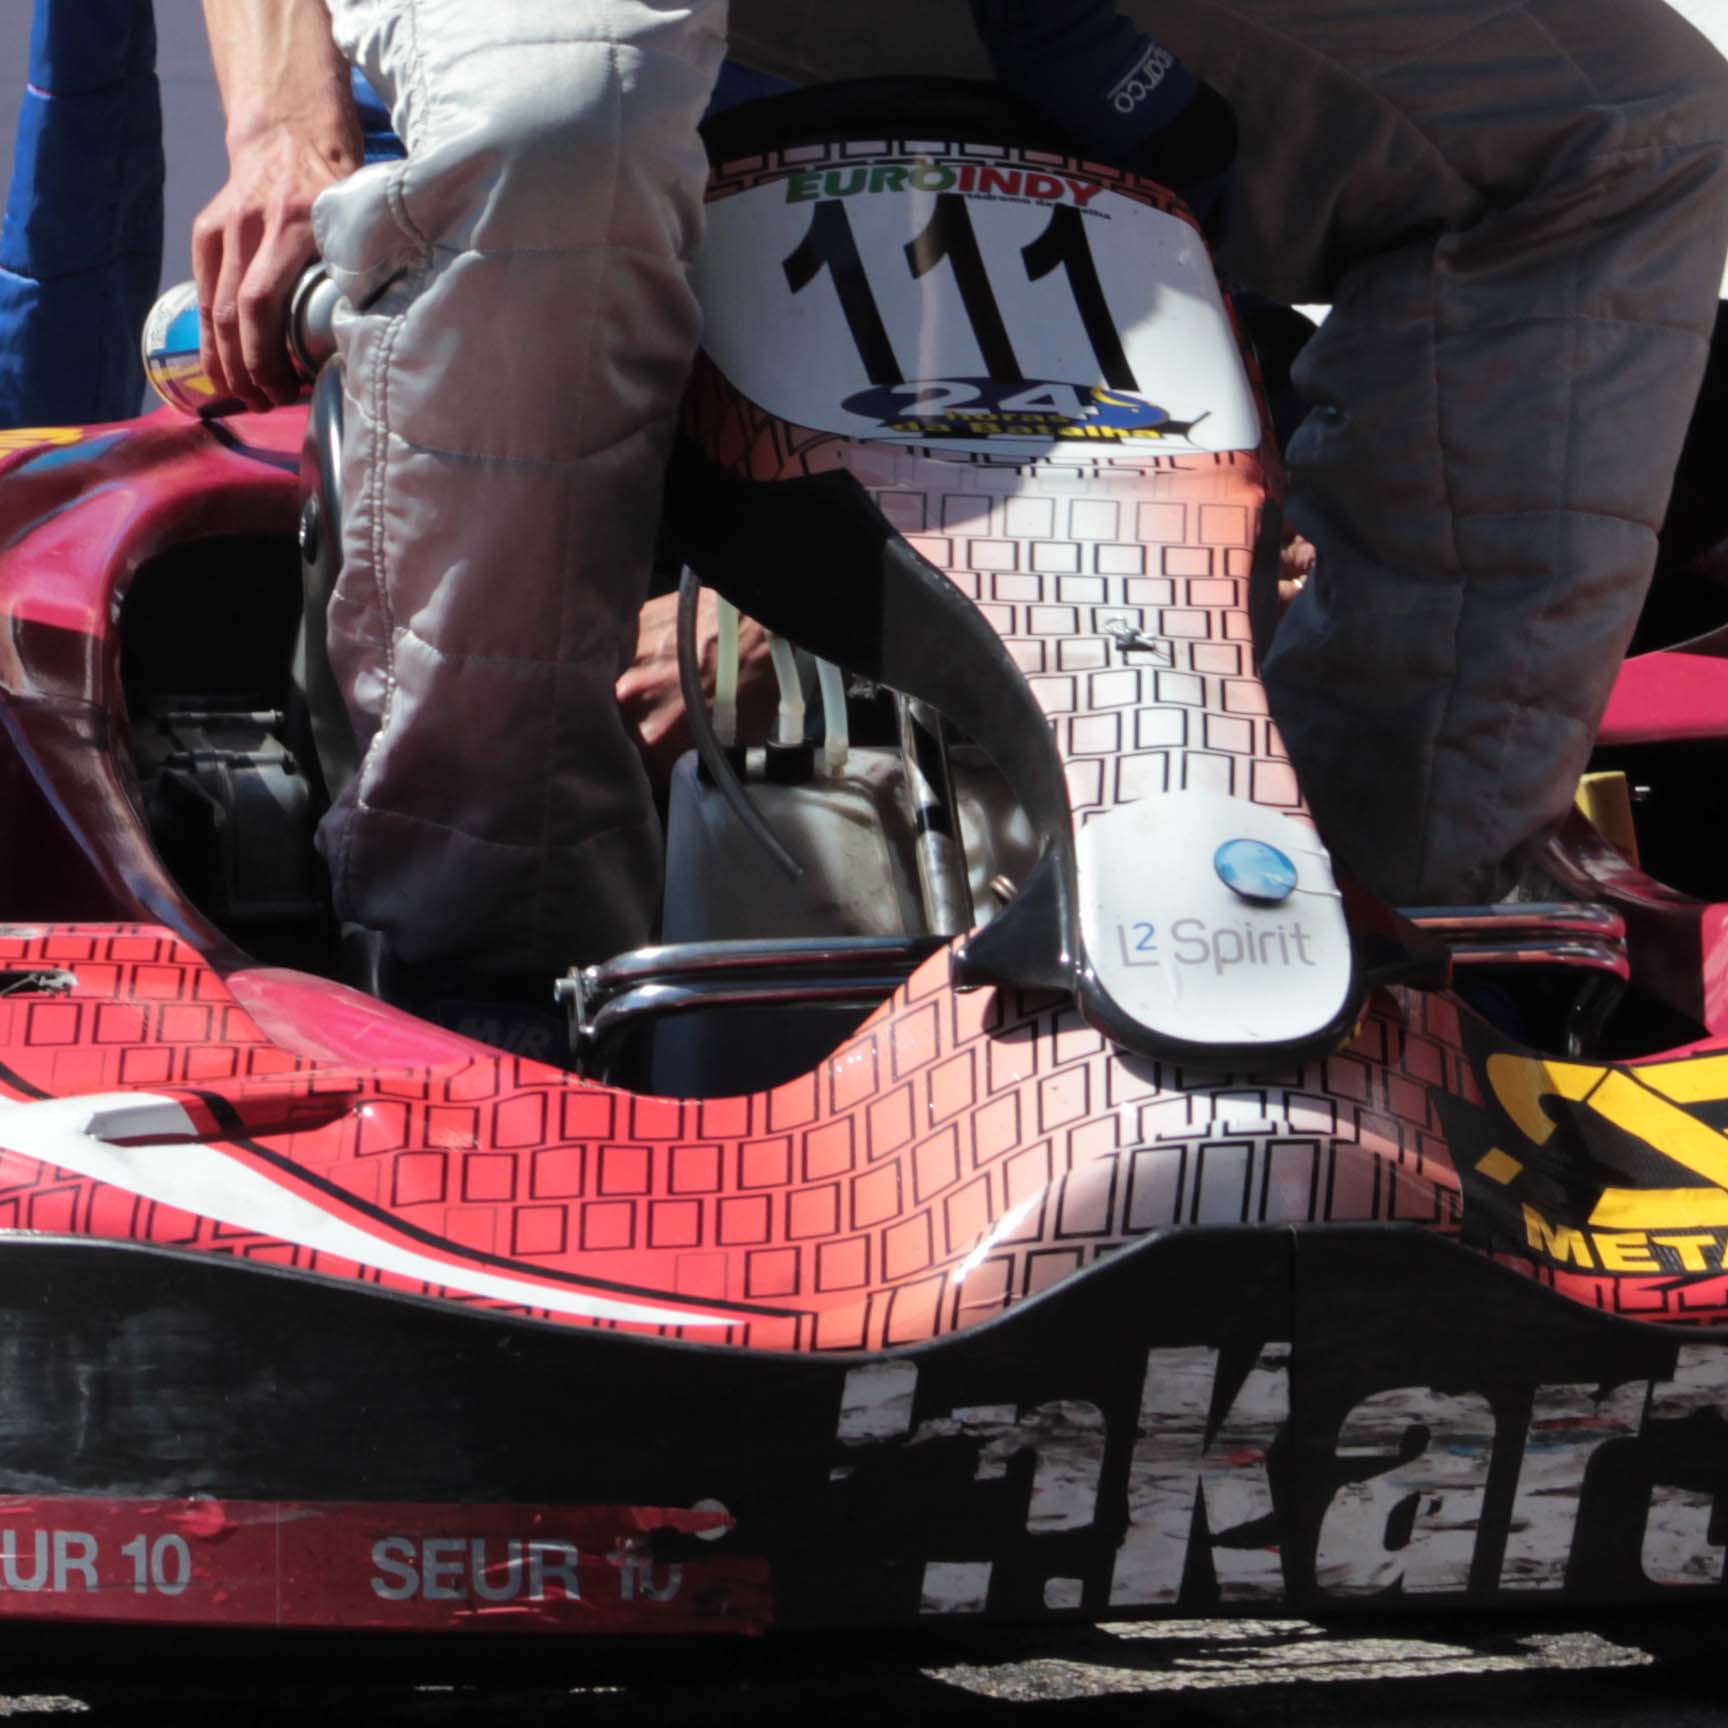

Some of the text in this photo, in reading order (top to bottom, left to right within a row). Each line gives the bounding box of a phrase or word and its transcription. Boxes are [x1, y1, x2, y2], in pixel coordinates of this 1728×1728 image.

[782, 193, 1140, 392] 111
[120, 1532, 192, 1597] 10
[369, 1535, 583, 1602] SEUR
